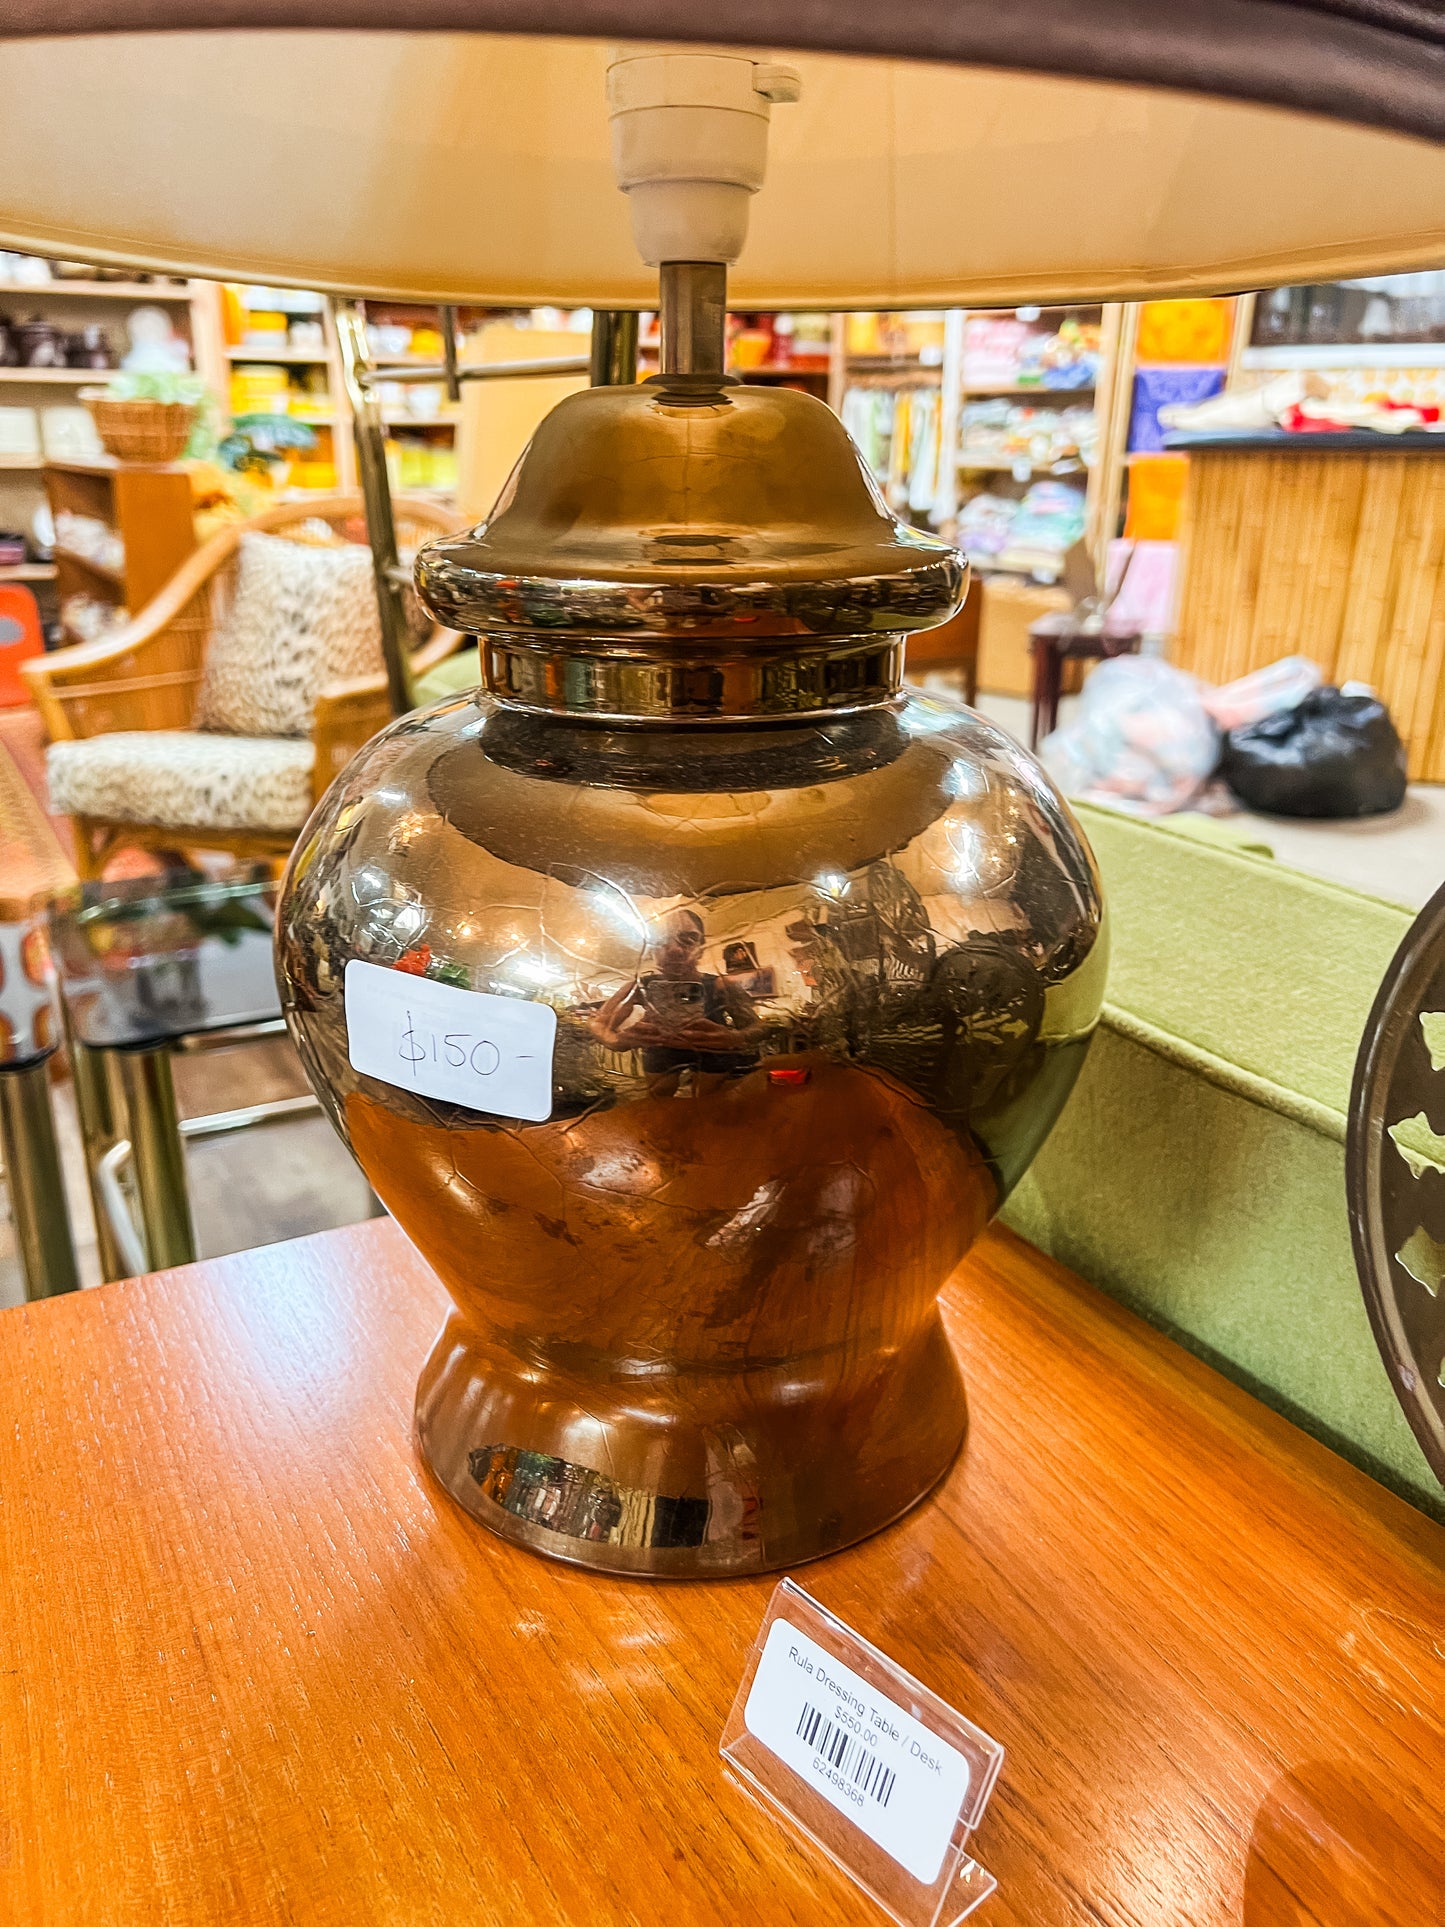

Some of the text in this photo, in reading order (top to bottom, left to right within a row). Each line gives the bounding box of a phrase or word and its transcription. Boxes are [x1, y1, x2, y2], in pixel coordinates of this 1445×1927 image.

[788, 1646, 814, 1675] Rula
[815, 1668, 866, 1718] Dressing
[869, 1707, 900, 1742] Table
[910, 1740, 944, 1776] Desk
[834, 1705, 878, 1747] $550.00
[812, 1757, 865, 1808] 62498368
